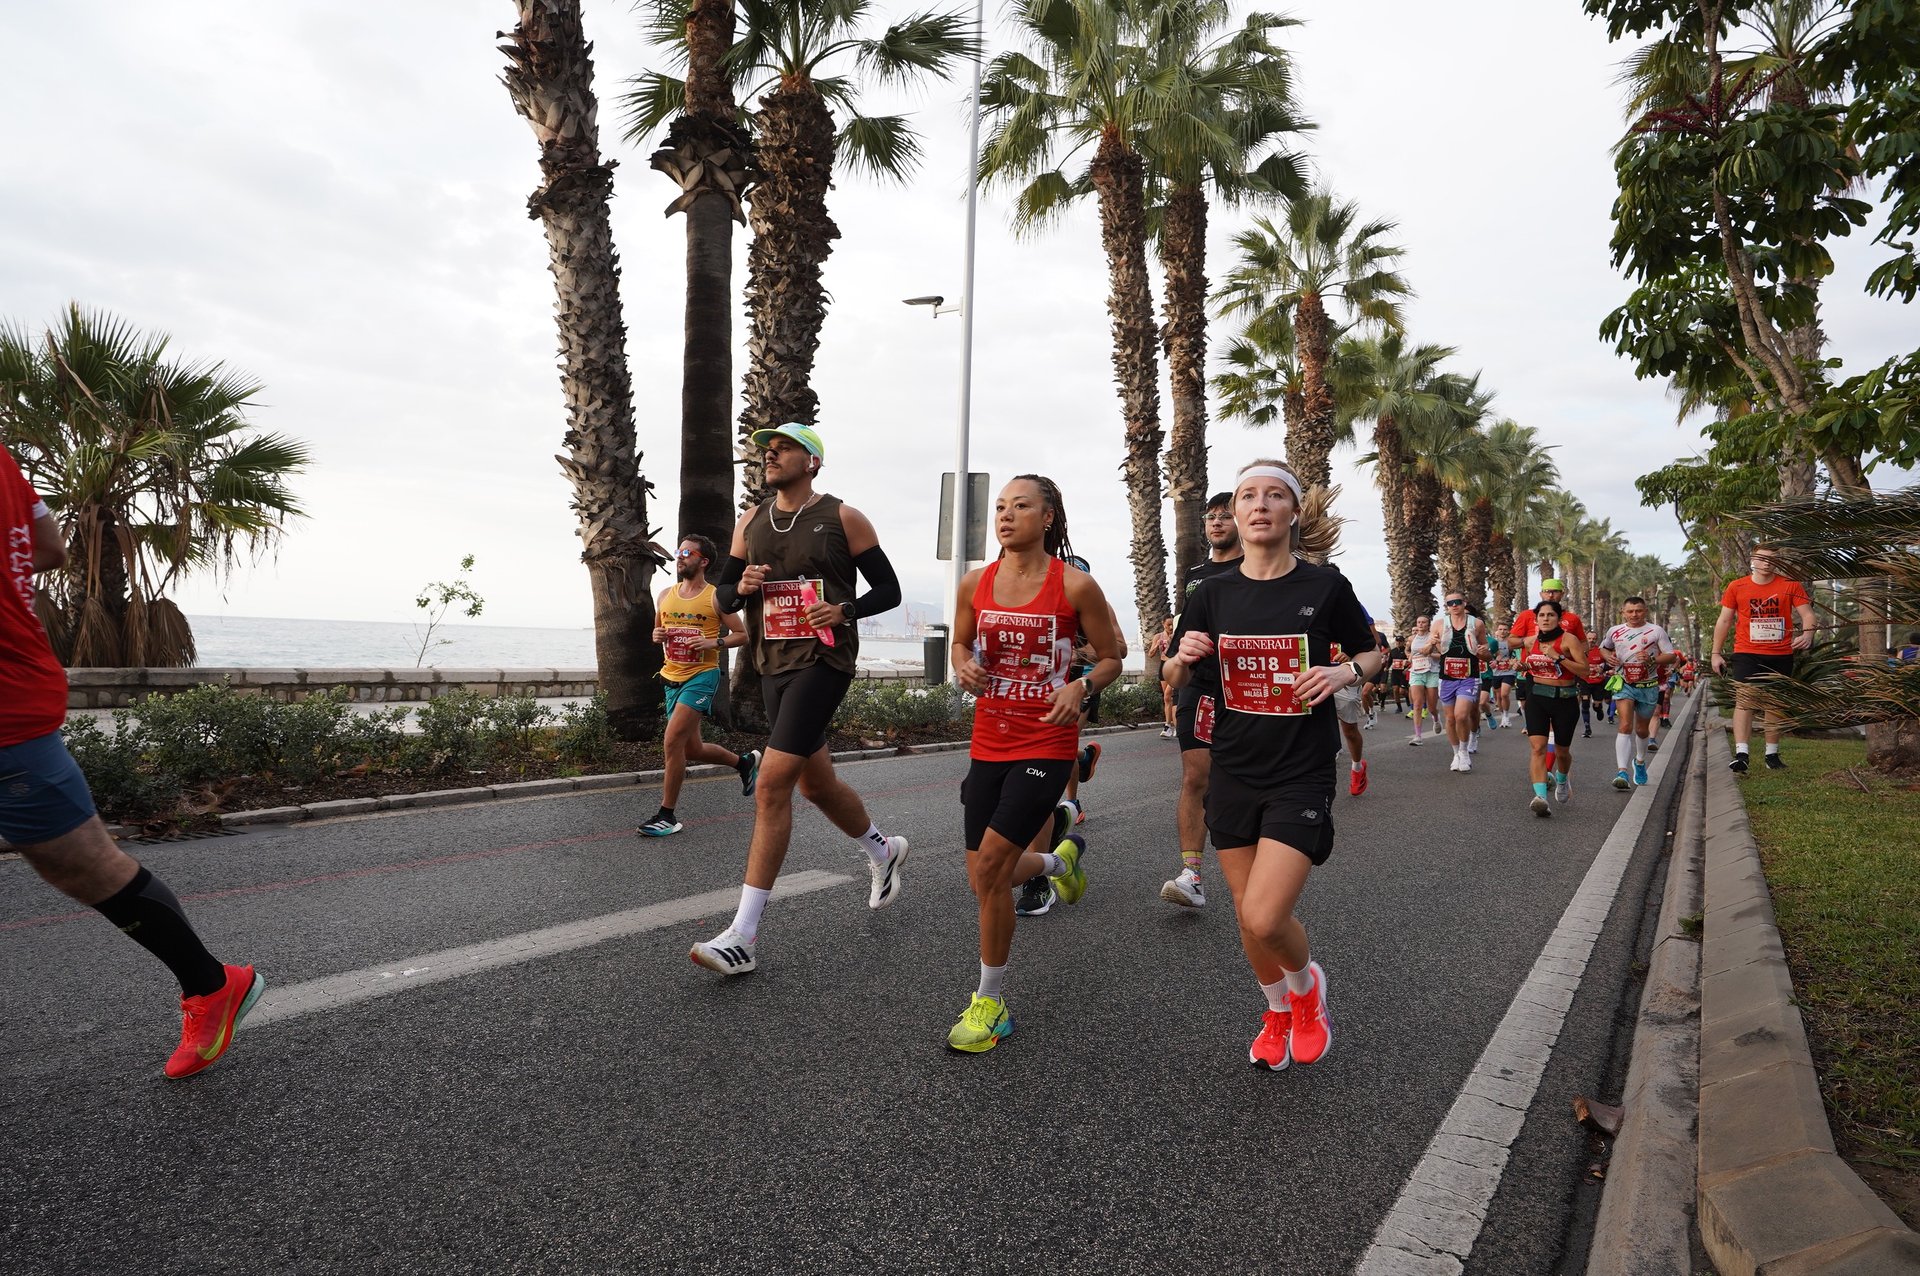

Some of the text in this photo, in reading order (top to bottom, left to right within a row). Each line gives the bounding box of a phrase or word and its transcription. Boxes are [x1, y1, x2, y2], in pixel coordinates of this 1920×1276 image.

[996, 615, 1043, 628] GENERALI
[998, 630, 1025, 644] 819
[1237, 639, 1293, 649] GENERALI
[1237, 656, 1279, 671] 8518
